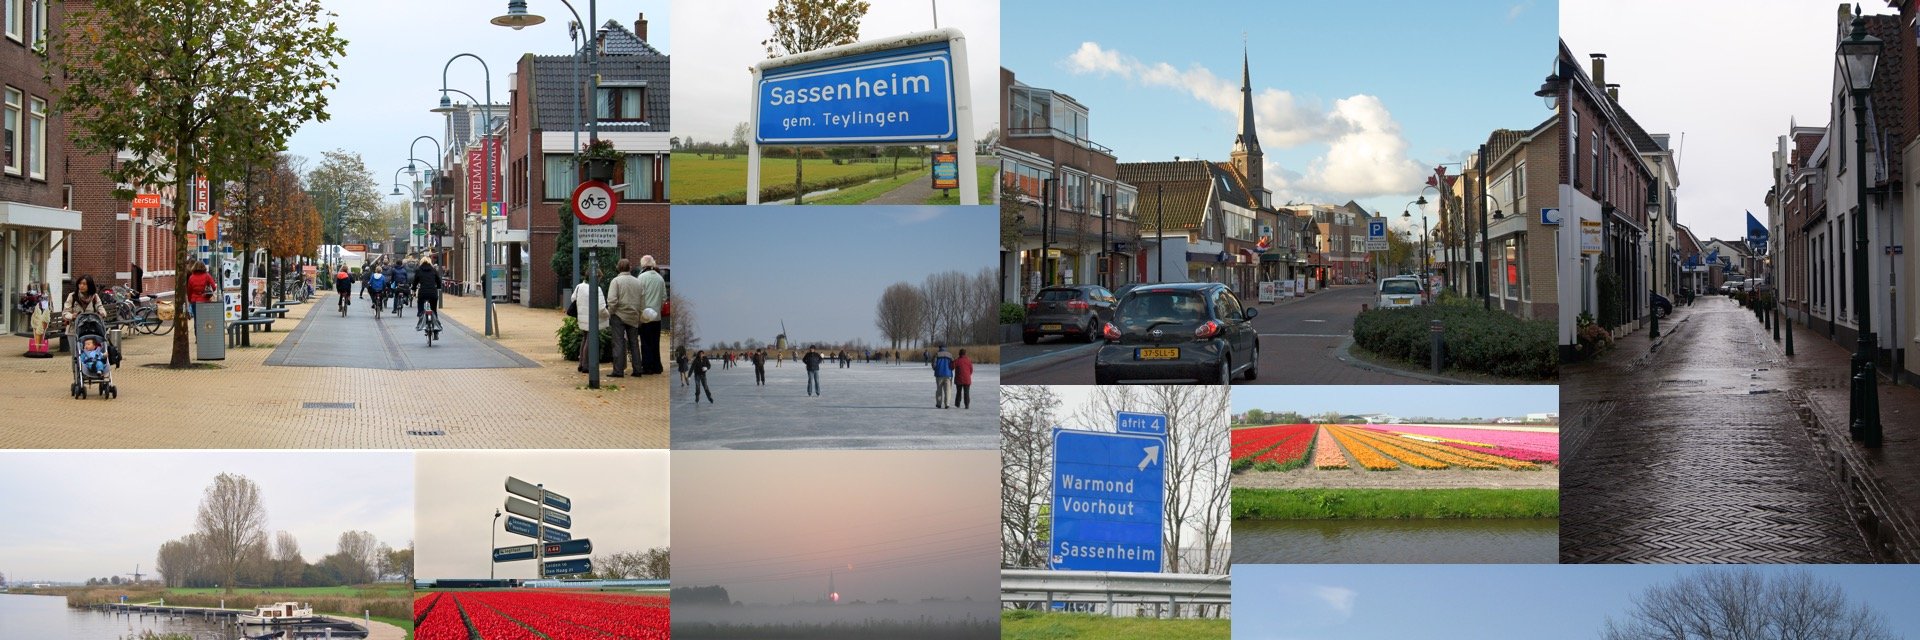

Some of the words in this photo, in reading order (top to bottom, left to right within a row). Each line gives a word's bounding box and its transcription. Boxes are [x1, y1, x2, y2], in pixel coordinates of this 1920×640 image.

[769, 72, 930, 106] Sassenheim
[782, 115, 816, 131] gem.
[822, 110, 909, 128] Teylingen
[472, 153, 482, 200] MELMAN
[198, 175, 208, 211] KER
[1143, 349, 1176, 357] 37-SLL-5
[1121, 417, 1146, 429] afrit
[1150, 418, 1160, 431] 4
[1062, 474, 1134, 494] Warmond
[1062, 497, 1134, 516] Voorhout
[1060, 541, 1155, 561] Sassenheim
